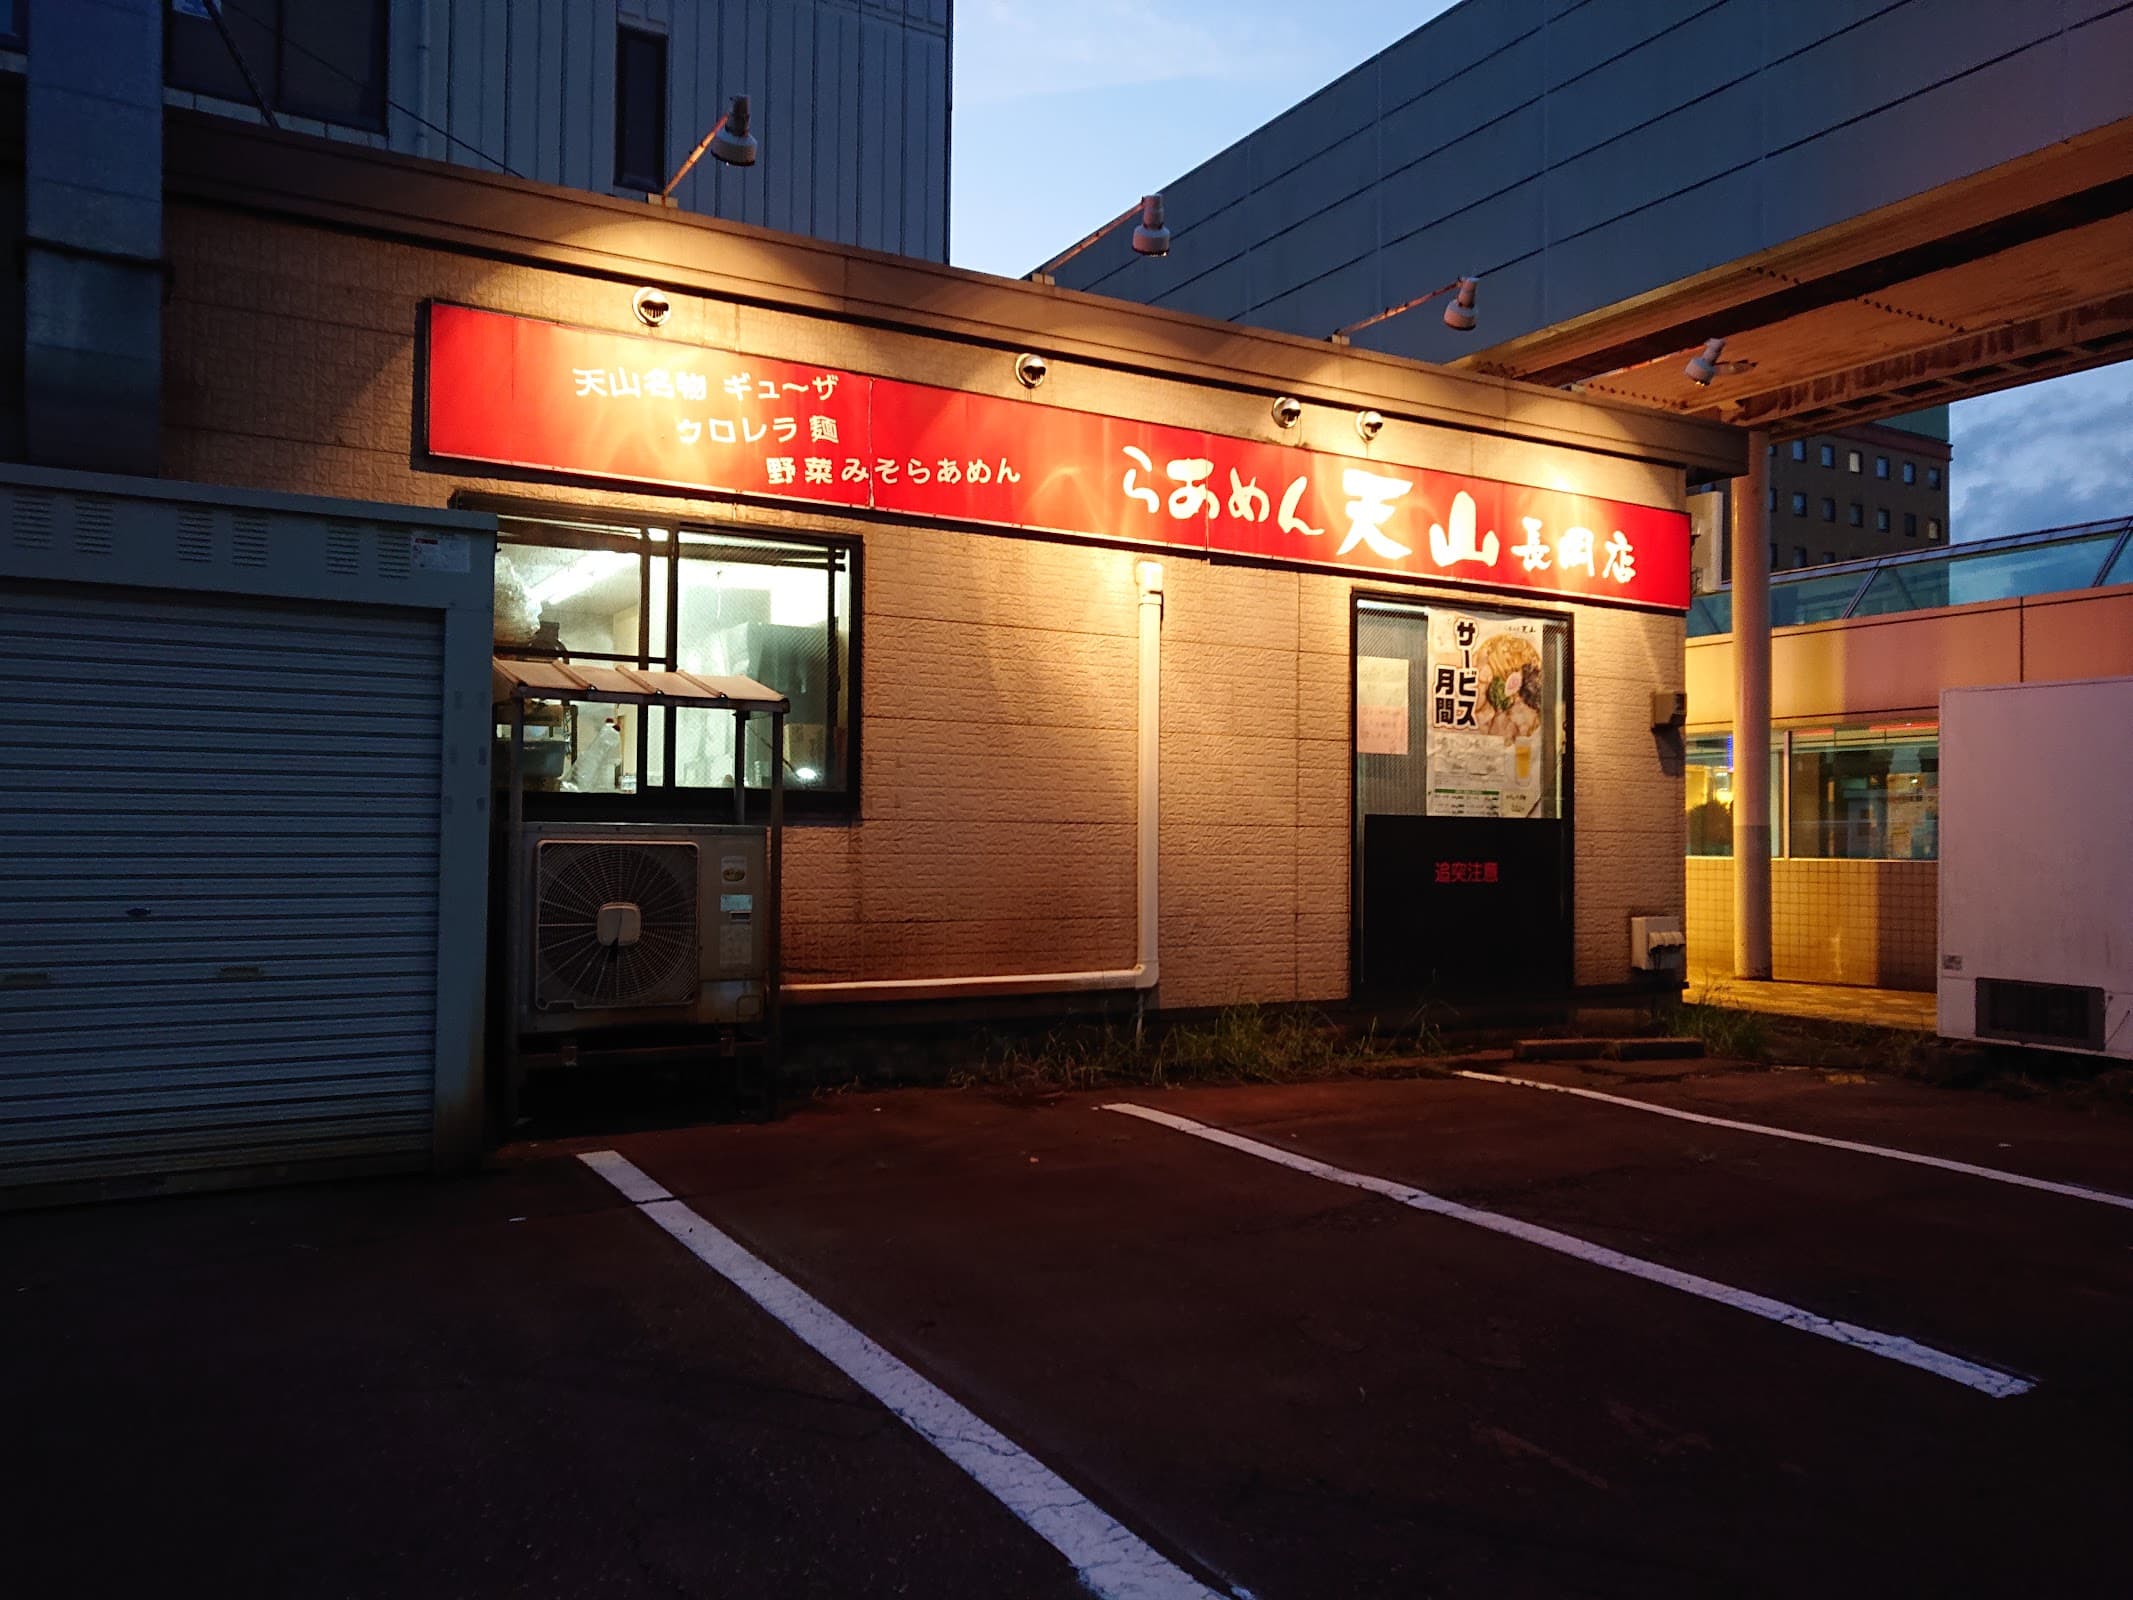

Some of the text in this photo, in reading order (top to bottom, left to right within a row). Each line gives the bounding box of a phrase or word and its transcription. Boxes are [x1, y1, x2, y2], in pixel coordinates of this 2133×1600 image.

[572, 367, 707, 400] 天山名物
[766, 457, 1021, 484] 野菜みそらあめん
[1336, 468, 1500, 568] 天山
[1436, 668, 1455, 724] 月間
[1457, 621, 1477, 726] サービス
